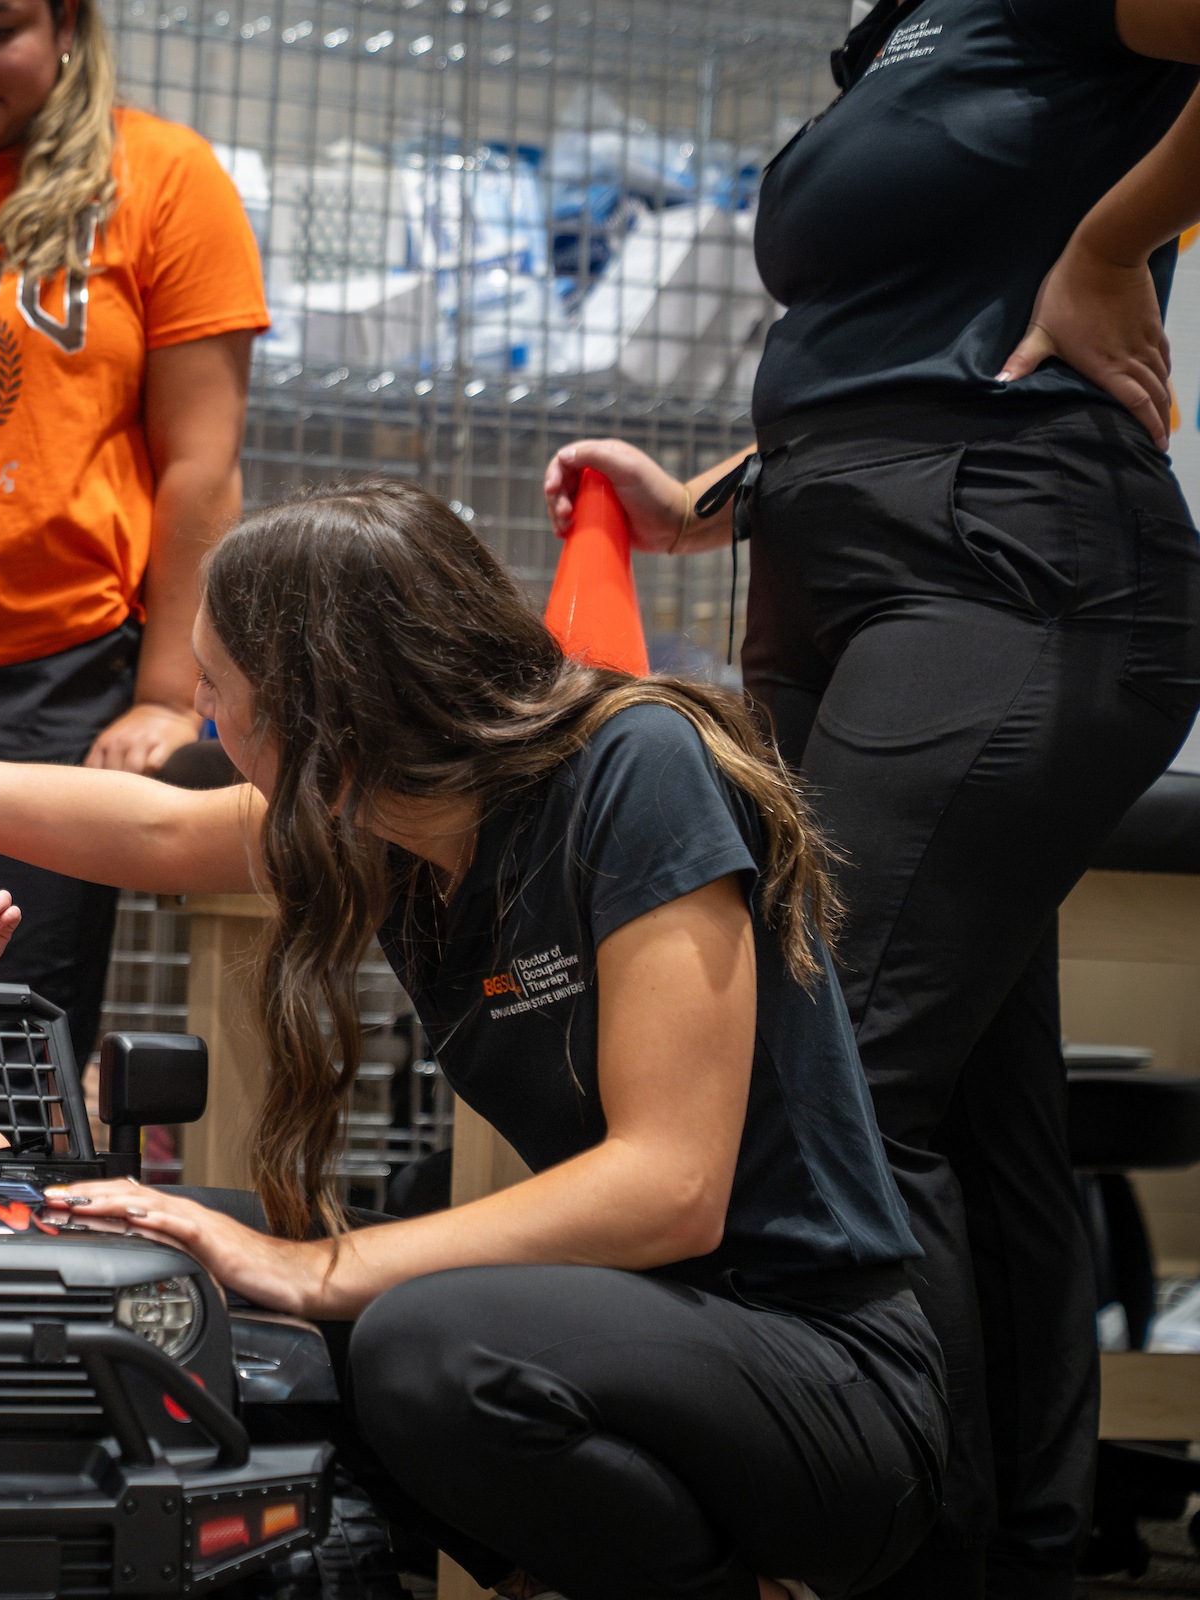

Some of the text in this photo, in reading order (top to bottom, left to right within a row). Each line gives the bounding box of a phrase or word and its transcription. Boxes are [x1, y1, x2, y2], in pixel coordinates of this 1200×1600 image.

[518, 944, 563, 971] Doctor of
[525, 971, 570, 993] Therapy
